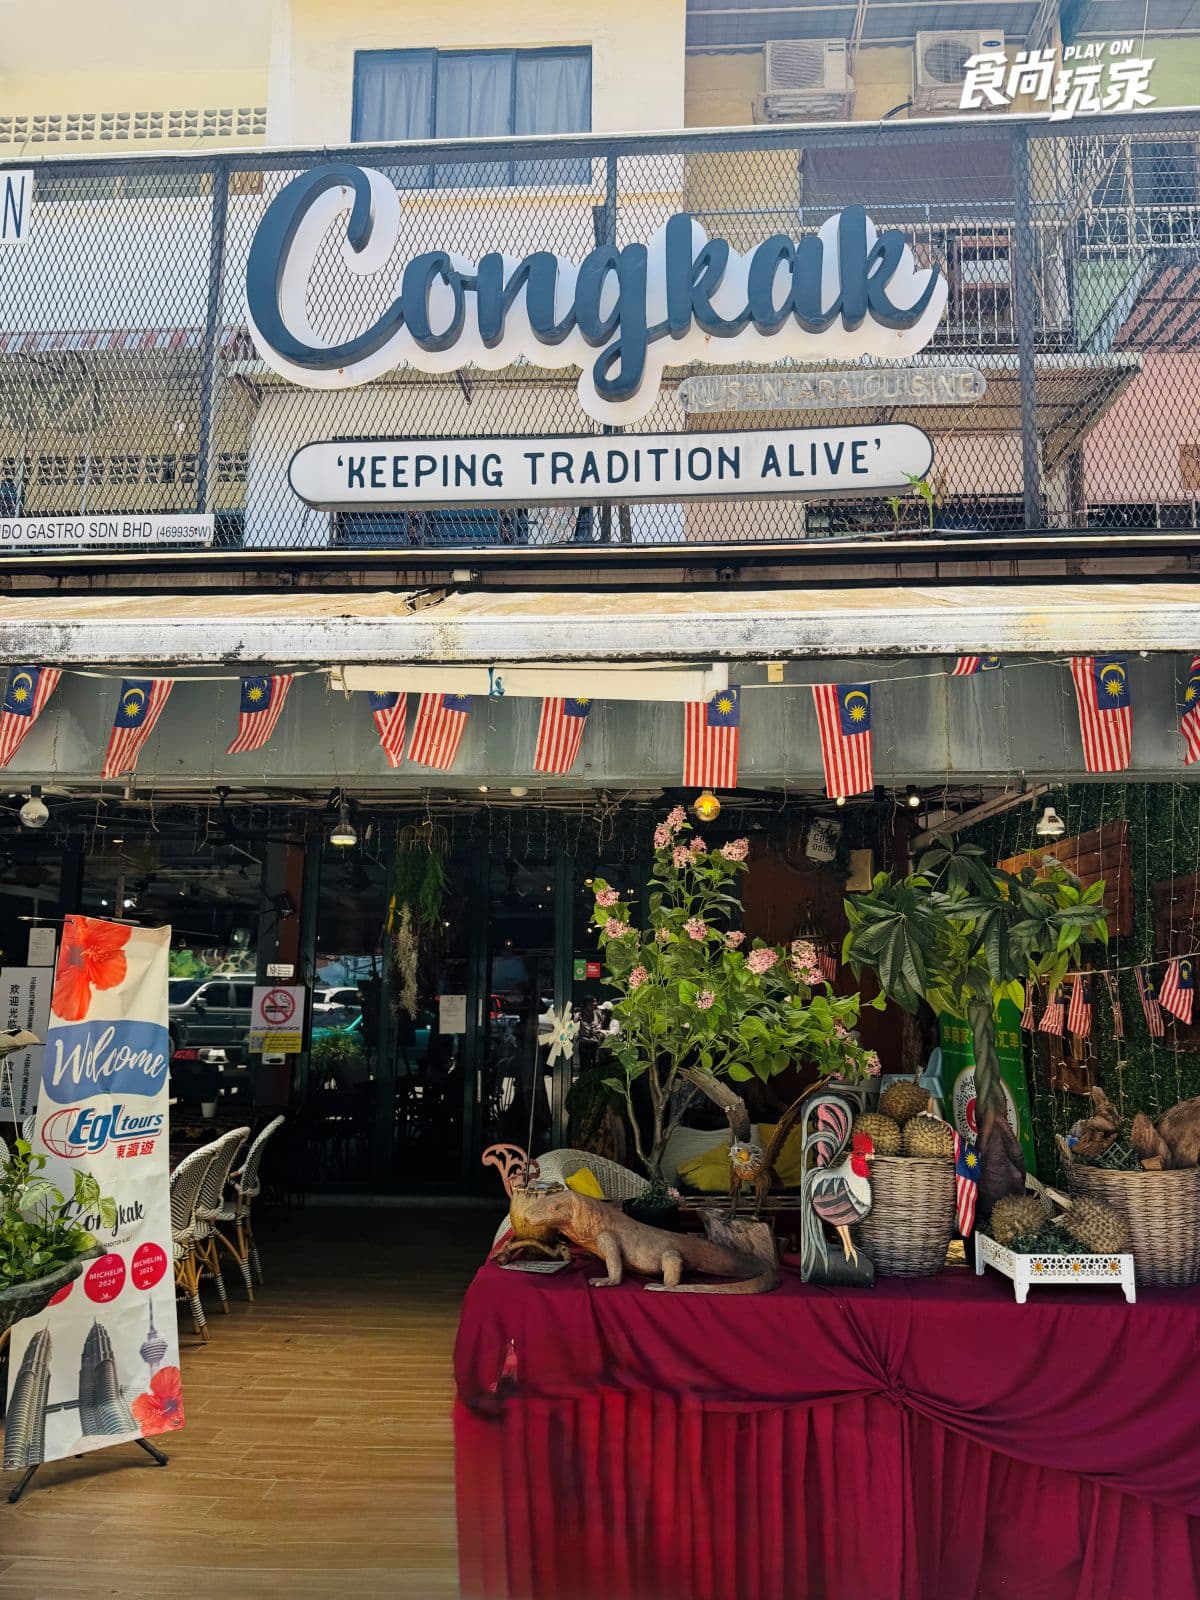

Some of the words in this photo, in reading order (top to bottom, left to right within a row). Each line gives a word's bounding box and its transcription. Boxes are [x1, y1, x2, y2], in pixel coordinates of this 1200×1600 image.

[246, 163, 940, 402] Congkak
[524, 447, 740, 485] TRADITION
[26, 522, 85, 539] GASTRO
[88, 522, 118, 538] SDN
[122, 522, 152, 538] BHD
[52, 1026, 166, 1086] Welcome
[121, 1114, 164, 1130] tours
[133, 1255, 163, 1268] MICHELIN
[89, 1267, 124, 1280] MICHELIN
[139, 1266, 154, 1275] 2025
